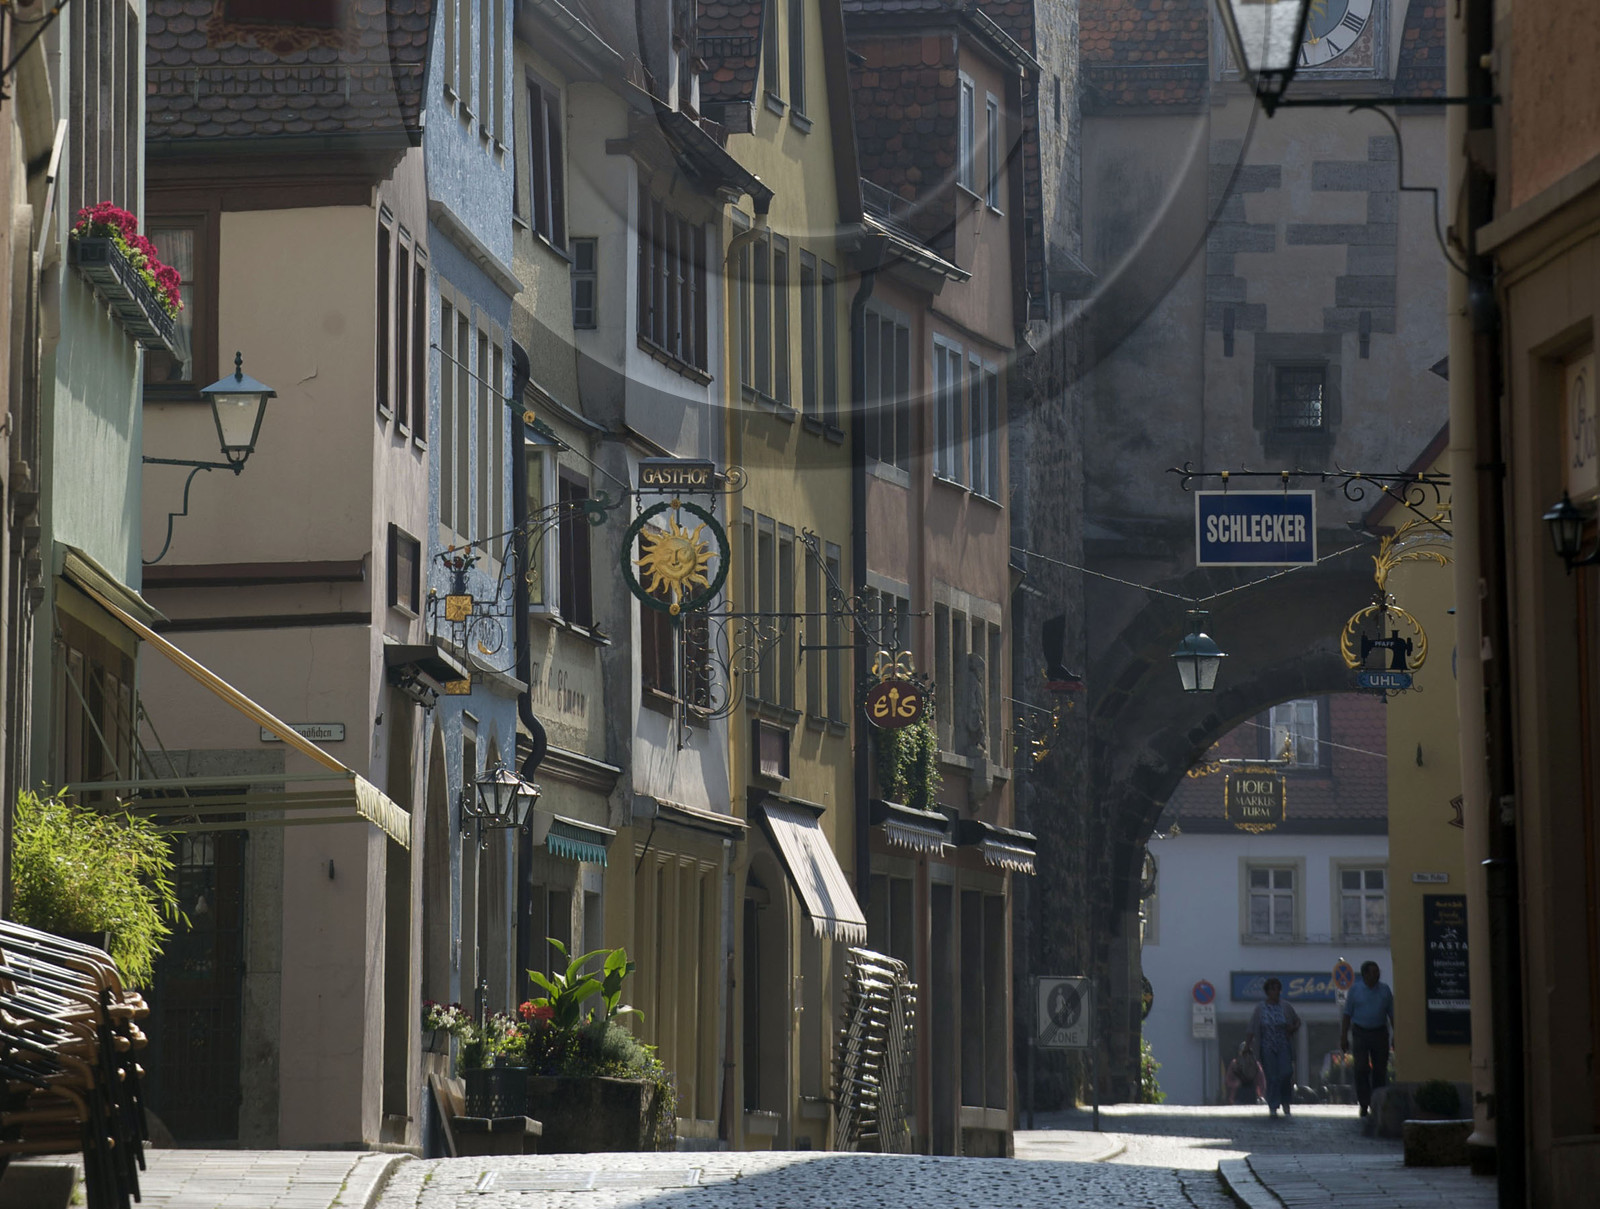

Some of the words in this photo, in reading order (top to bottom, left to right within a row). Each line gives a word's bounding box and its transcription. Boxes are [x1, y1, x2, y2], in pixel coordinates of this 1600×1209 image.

[642, 467, 711, 485] GASTHOF
[1206, 514, 1306, 543] SCHLECKER
[1369, 675, 1401, 686] UHL
[873, 687, 917, 718] EIS
[1236, 779, 1274, 795] HOTEL
[1235, 796, 1276, 806] MARKUS
[1242, 806, 1270, 816] TURM
[1430, 941, 1468, 950] PASTA
[1052, 1031, 1078, 1044] ZONE
